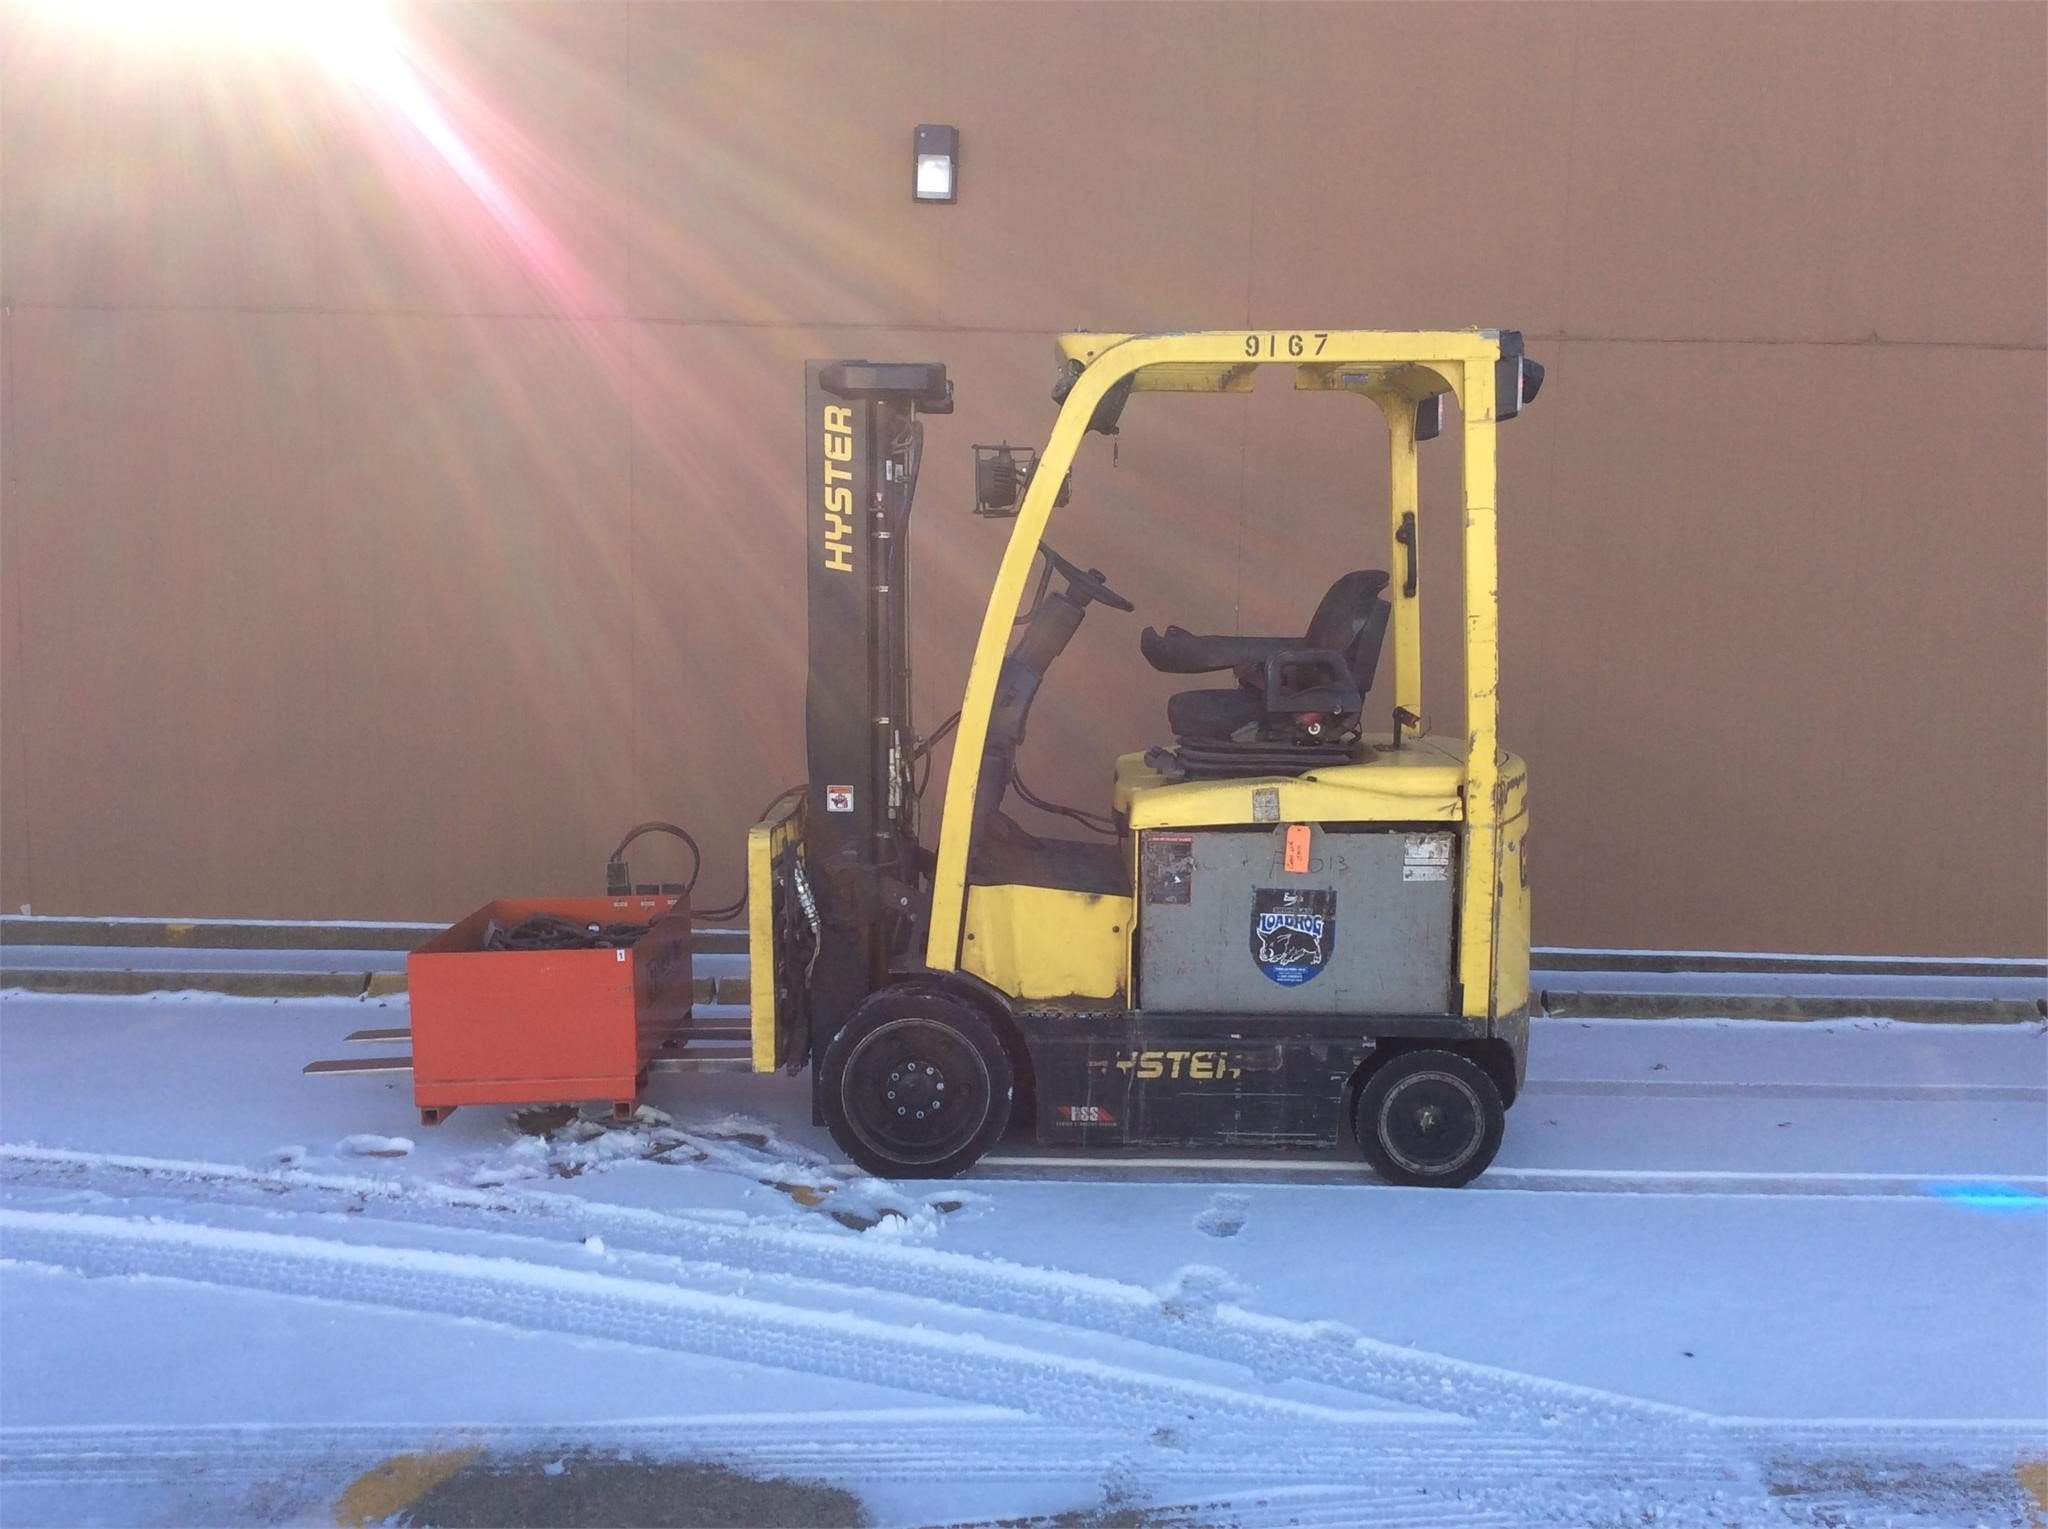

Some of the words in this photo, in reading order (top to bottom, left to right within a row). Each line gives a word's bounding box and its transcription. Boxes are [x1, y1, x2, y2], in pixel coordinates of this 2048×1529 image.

[1244, 333, 1328, 357] 9167
[824, 404, 853, 572] HYSTER
[1260, 913, 1324, 938] LOADHOG
